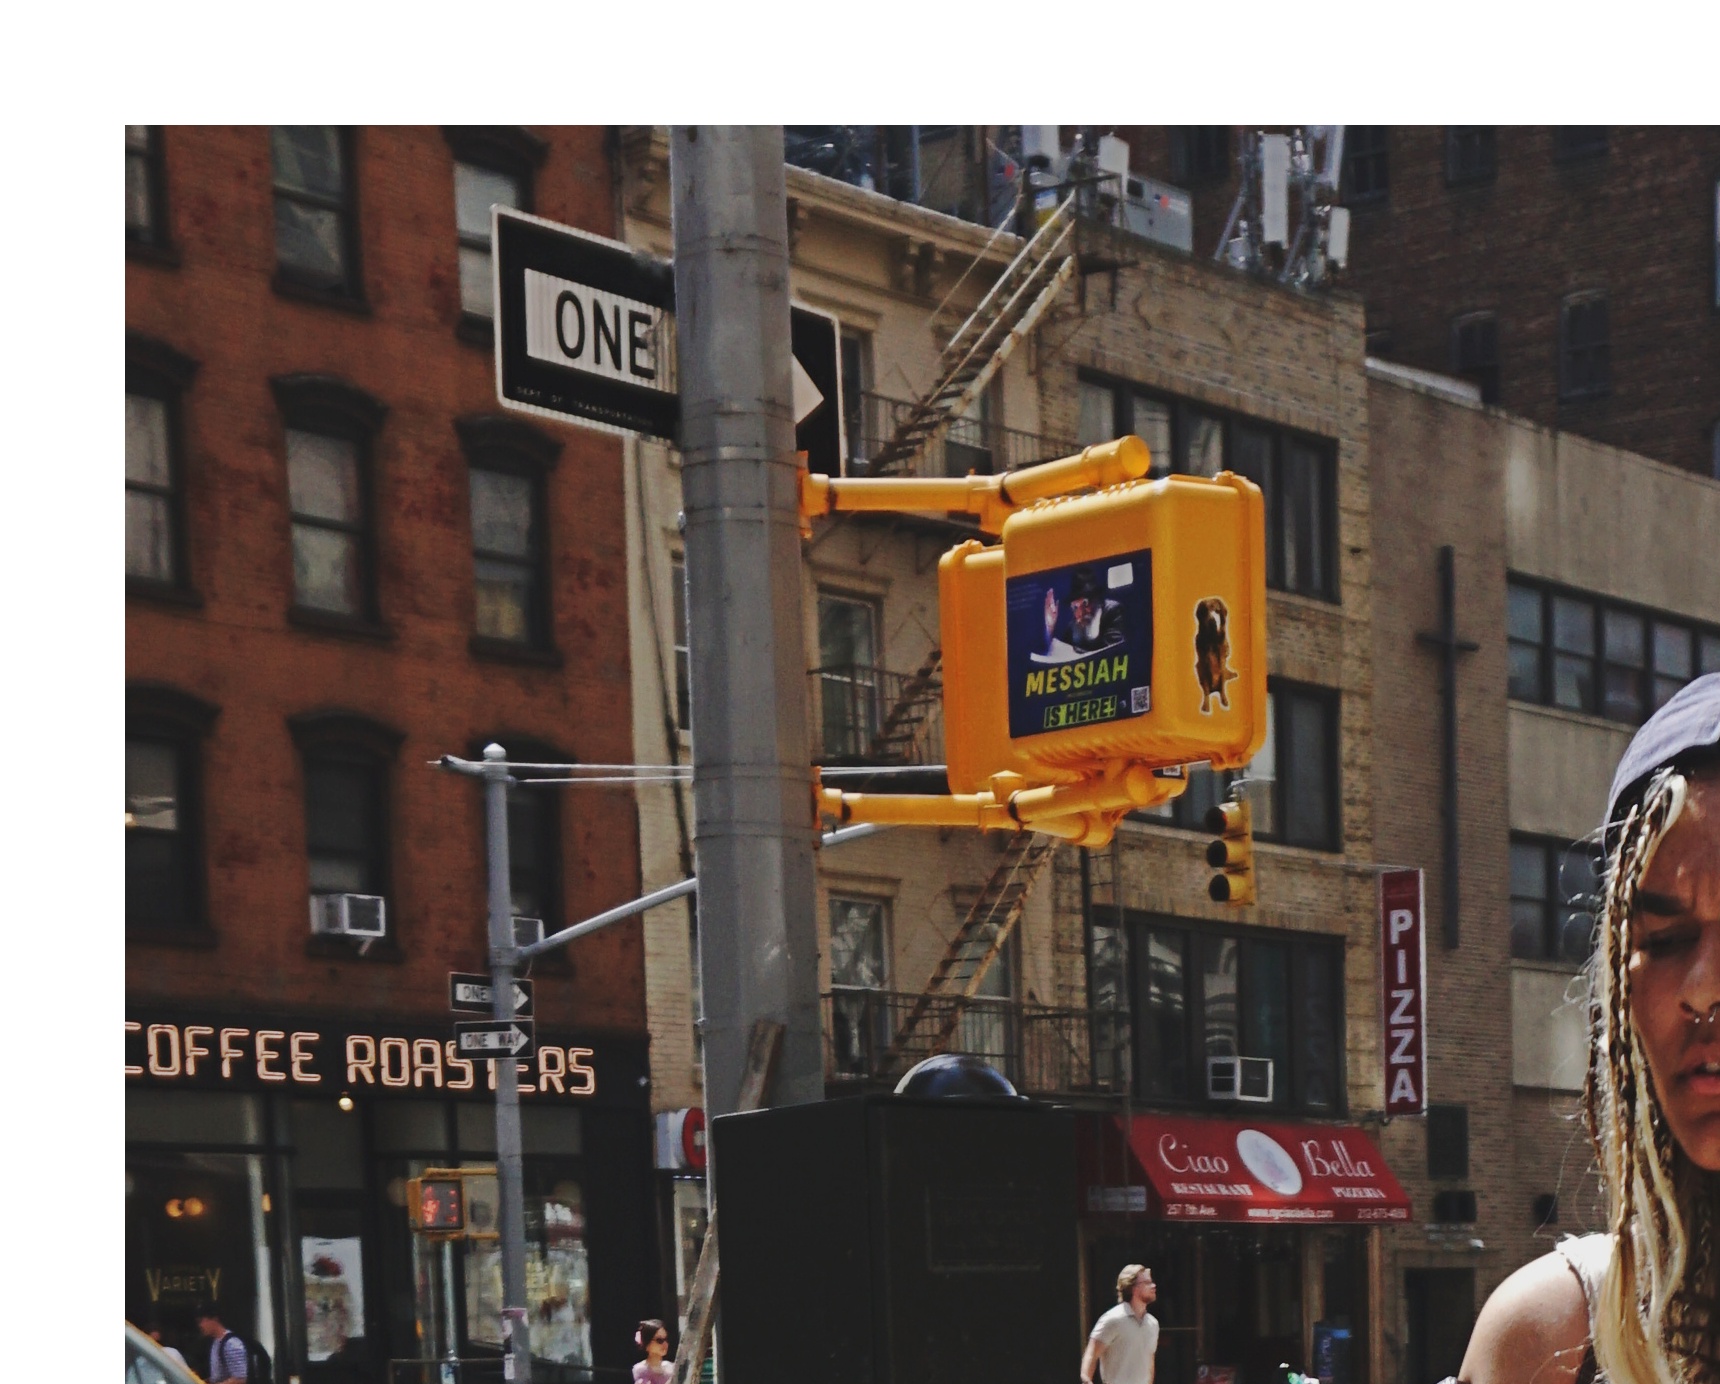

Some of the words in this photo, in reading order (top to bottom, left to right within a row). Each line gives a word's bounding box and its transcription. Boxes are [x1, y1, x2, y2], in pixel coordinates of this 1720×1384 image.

[556, 290, 655, 380] ONE
[1025, 654, 1129, 698] MESSIAH
[1044, 706, 1062, 728] IS
[1065, 696, 1117, 724] HERE!
[463, 985, 488, 1001] ONE
[1389, 909, 1418, 1104] PIZZA
[465, 1033, 489, 1048] ONE
[498, 1031, 522, 1048] WAY
[1159, 1133, 1229, 1174] Ciao
[1301, 1139, 1376, 1178] Bella
